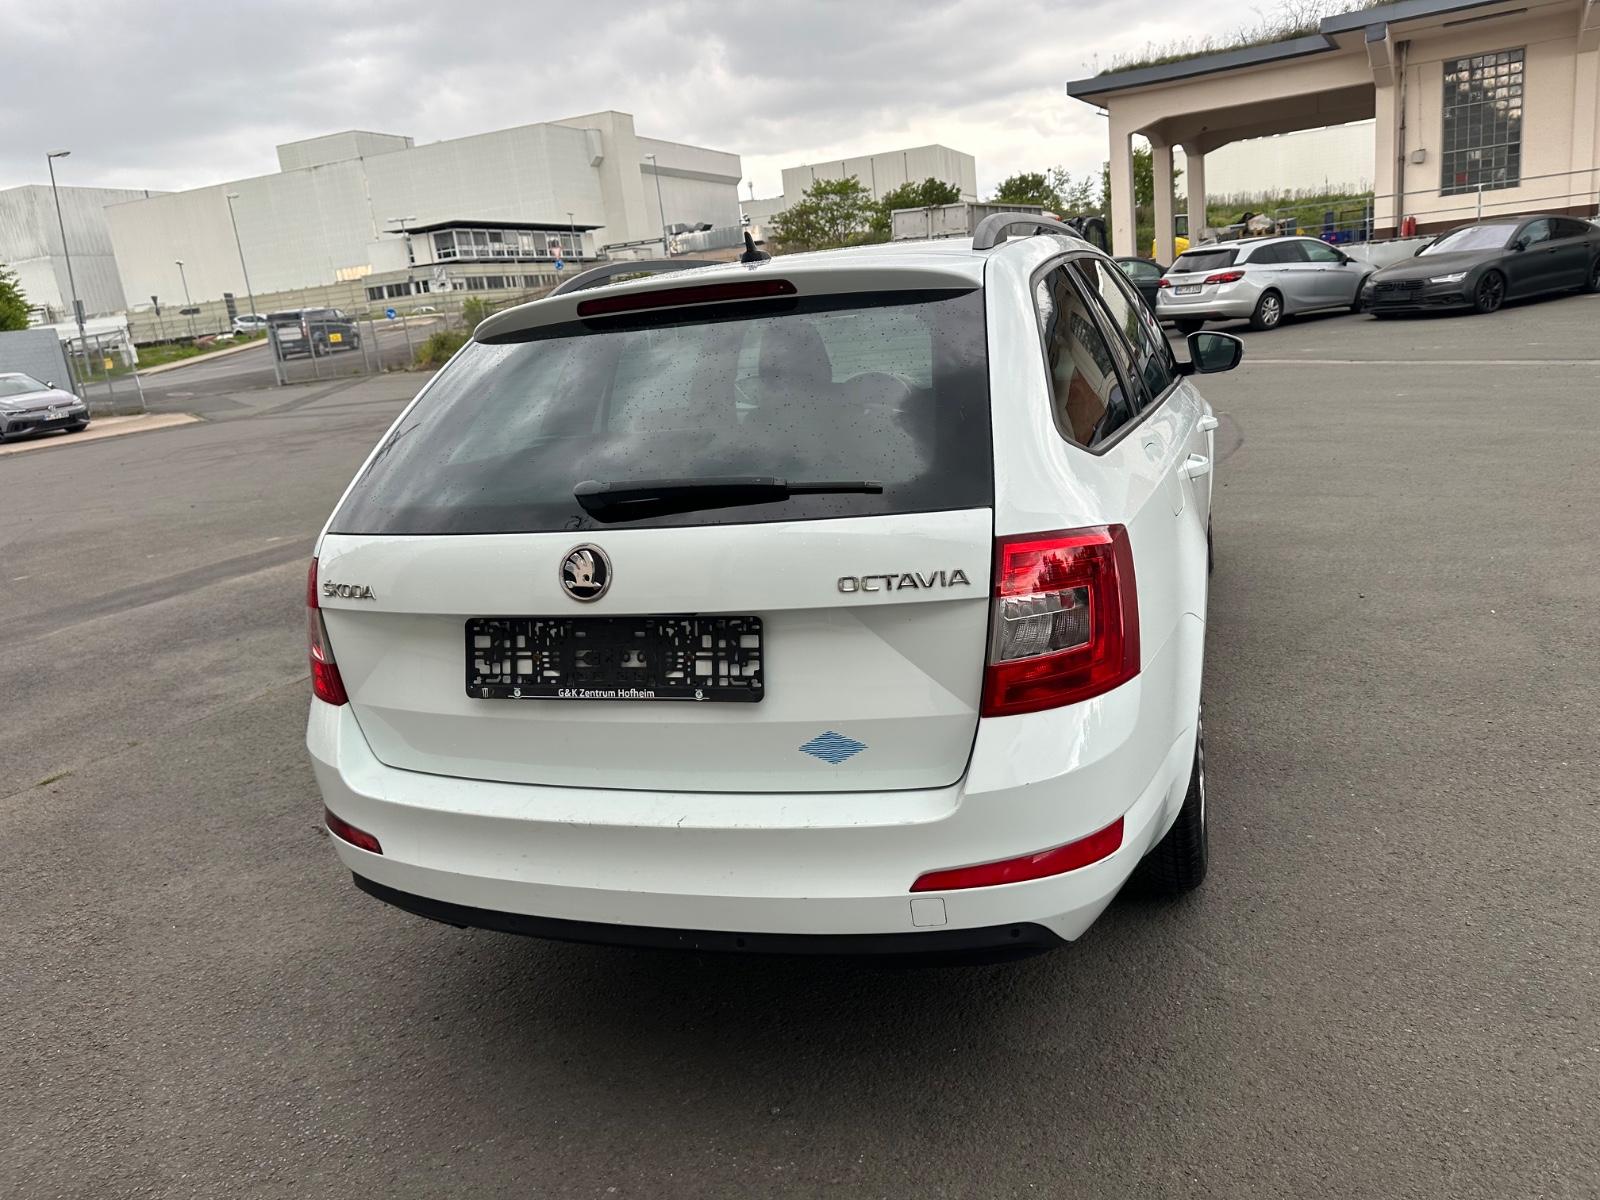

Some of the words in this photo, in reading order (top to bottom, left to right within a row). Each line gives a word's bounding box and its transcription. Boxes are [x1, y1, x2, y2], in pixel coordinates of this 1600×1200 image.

[838, 569, 971, 592] OCTAVIA
[558, 688, 577, 698] G&K
[580, 688, 615, 698] Zentrum
[618, 688, 655, 698] Hofheim
